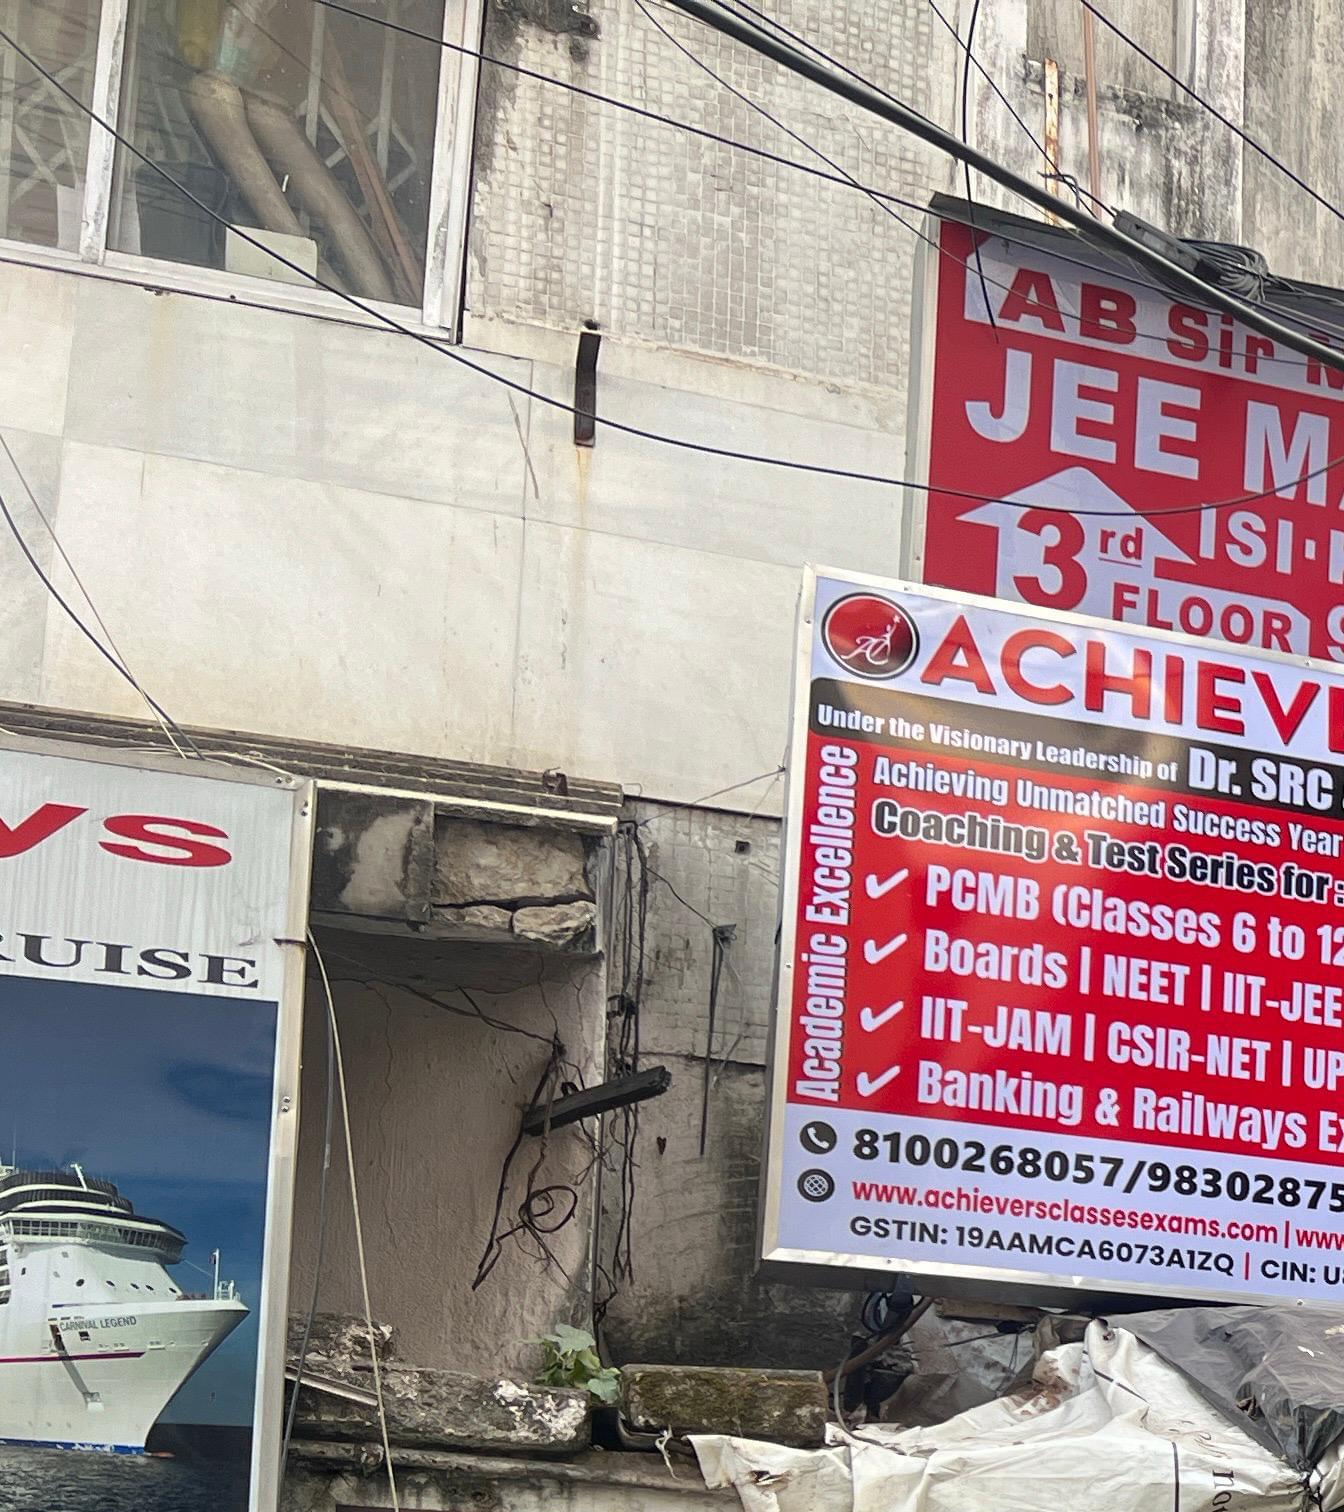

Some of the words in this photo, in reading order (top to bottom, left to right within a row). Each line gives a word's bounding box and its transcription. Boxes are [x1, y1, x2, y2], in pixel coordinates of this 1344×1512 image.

[998, 268, 1138, 345] AB
[1167, 303, 1275, 374] Sir
[964, 349, 1202, 481] JEE
[1012, 508, 1144, 612] 3rd
[1112, 582, 1294, 655] FLOOR
[817, 703, 887, 735] Under
[888, 717, 926, 742] the
[929, 723, 1032, 762] Visionary
[1035, 743, 1155, 782] Leadership
[1157, 760, 1179, 782] of
[1188, 747, 1242, 797] Dr.
[1251, 762, 1334, 811] SRC
[804, 745, 859, 926] Excellence
[0, 932, 260, 989] UISE
[926, 865, 1042, 921] PCMB
[1052, 884, 1221, 946] (Classes
[1232, 912, 1257, 952] 6
[1267, 922, 1305, 960] to
[796, 933, 849, 1102] Academic
[850, 1214, 949, 1246] GSTIN:
[1260, 1257, 1317, 1284] CIN:
[851, 1178, 1278, 1244] www.achieversclassesexams.com
[59, 1317, 99, 1332] CARNIVAL
[101, 1313, 138, 1329] LEGEND
